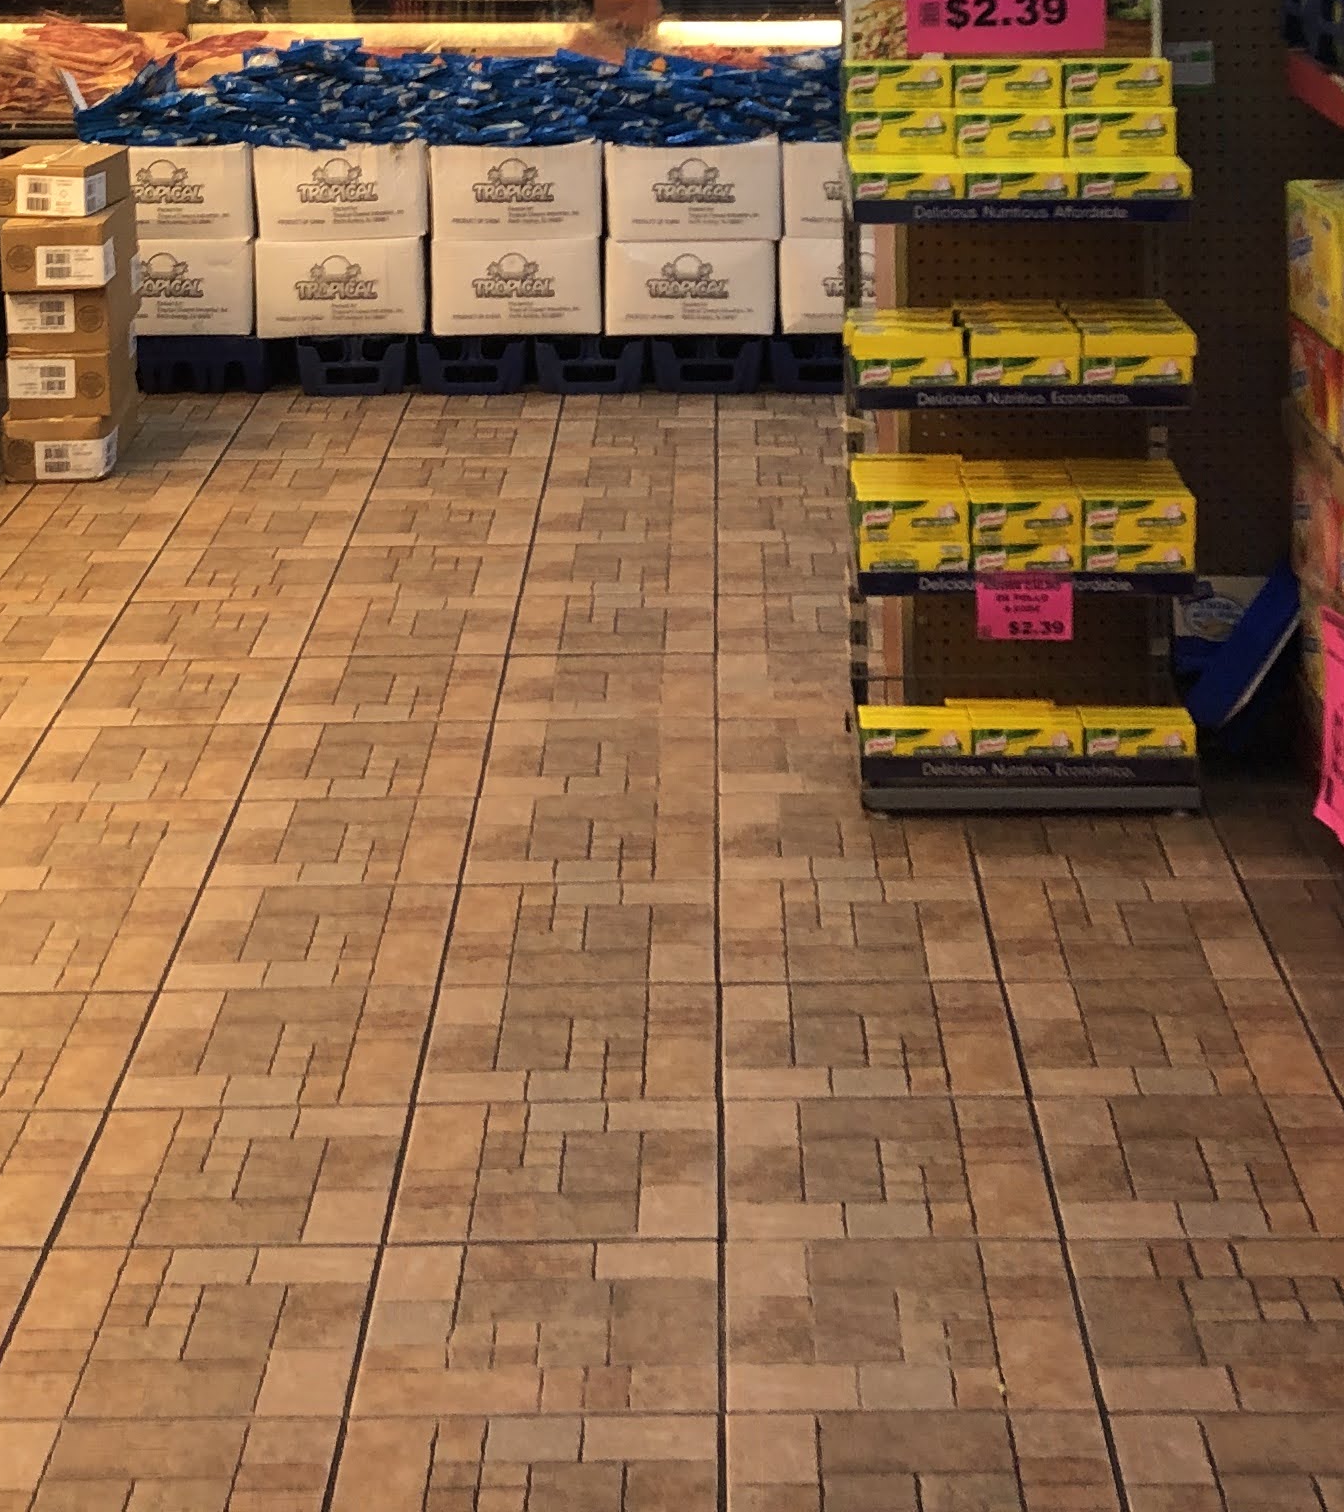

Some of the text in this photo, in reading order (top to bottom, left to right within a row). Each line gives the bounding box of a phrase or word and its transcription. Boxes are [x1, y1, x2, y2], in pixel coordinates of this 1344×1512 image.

[132, 183, 204, 203] ROPICAL
[297, 182, 378, 203] TROPICAL
[472, 182, 555, 203] TROPICAL
[652, 182, 736, 204] TROPICAL
[295, 279, 378, 300] TROPICAL
[472, 278, 555, 299] TROPICAL
[646, 278, 729, 299] TROPICAL
